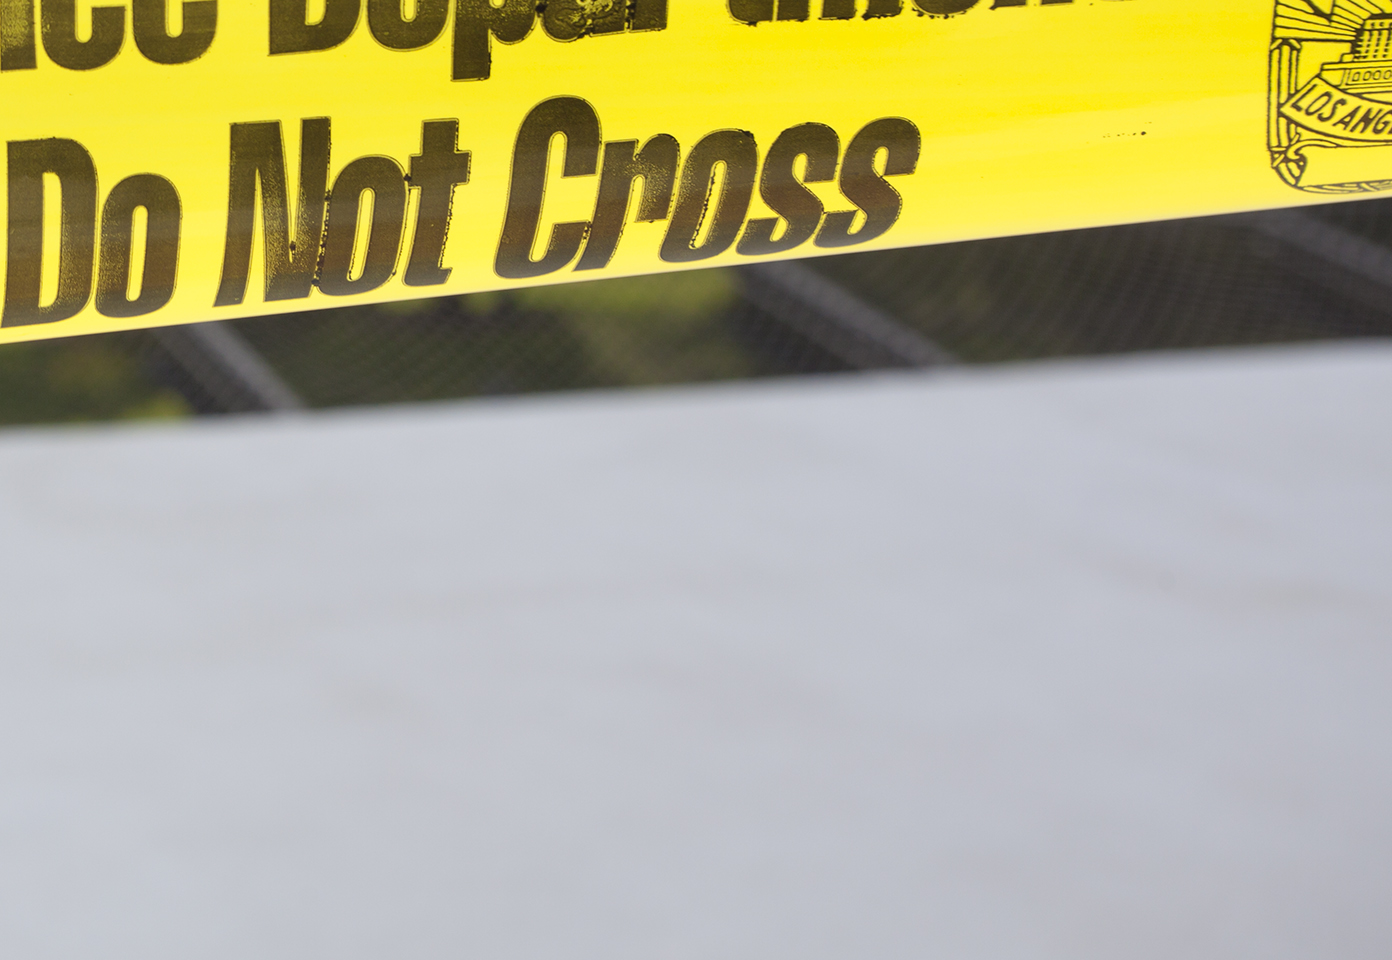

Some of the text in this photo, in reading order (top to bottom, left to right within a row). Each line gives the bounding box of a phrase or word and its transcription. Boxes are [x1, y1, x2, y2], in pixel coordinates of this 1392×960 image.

[1290, 83, 1392, 136] LOS ANG
[0, 136, 181, 329] Do
[213, 116, 471, 307] Not
[494, 96, 922, 279] Cross
